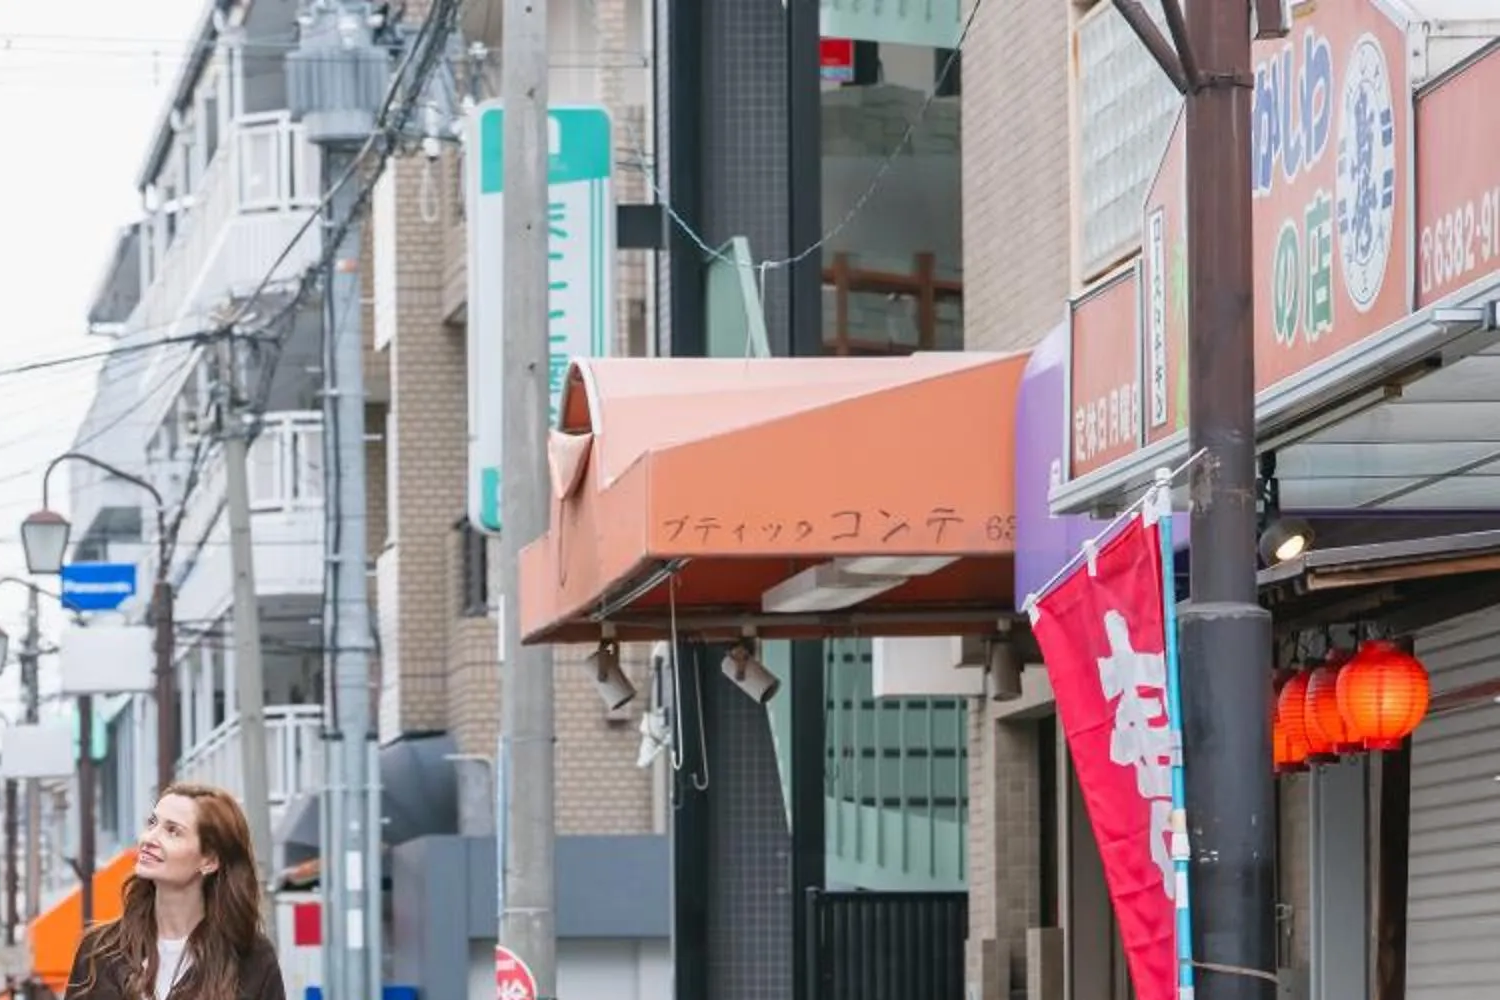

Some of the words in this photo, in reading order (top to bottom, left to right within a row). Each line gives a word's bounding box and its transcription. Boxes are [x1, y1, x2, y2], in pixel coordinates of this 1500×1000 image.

[1274, 189, 1332, 346] の店
[663, 515, 814, 543] ブティック
[831, 507, 965, 544] コンテ
